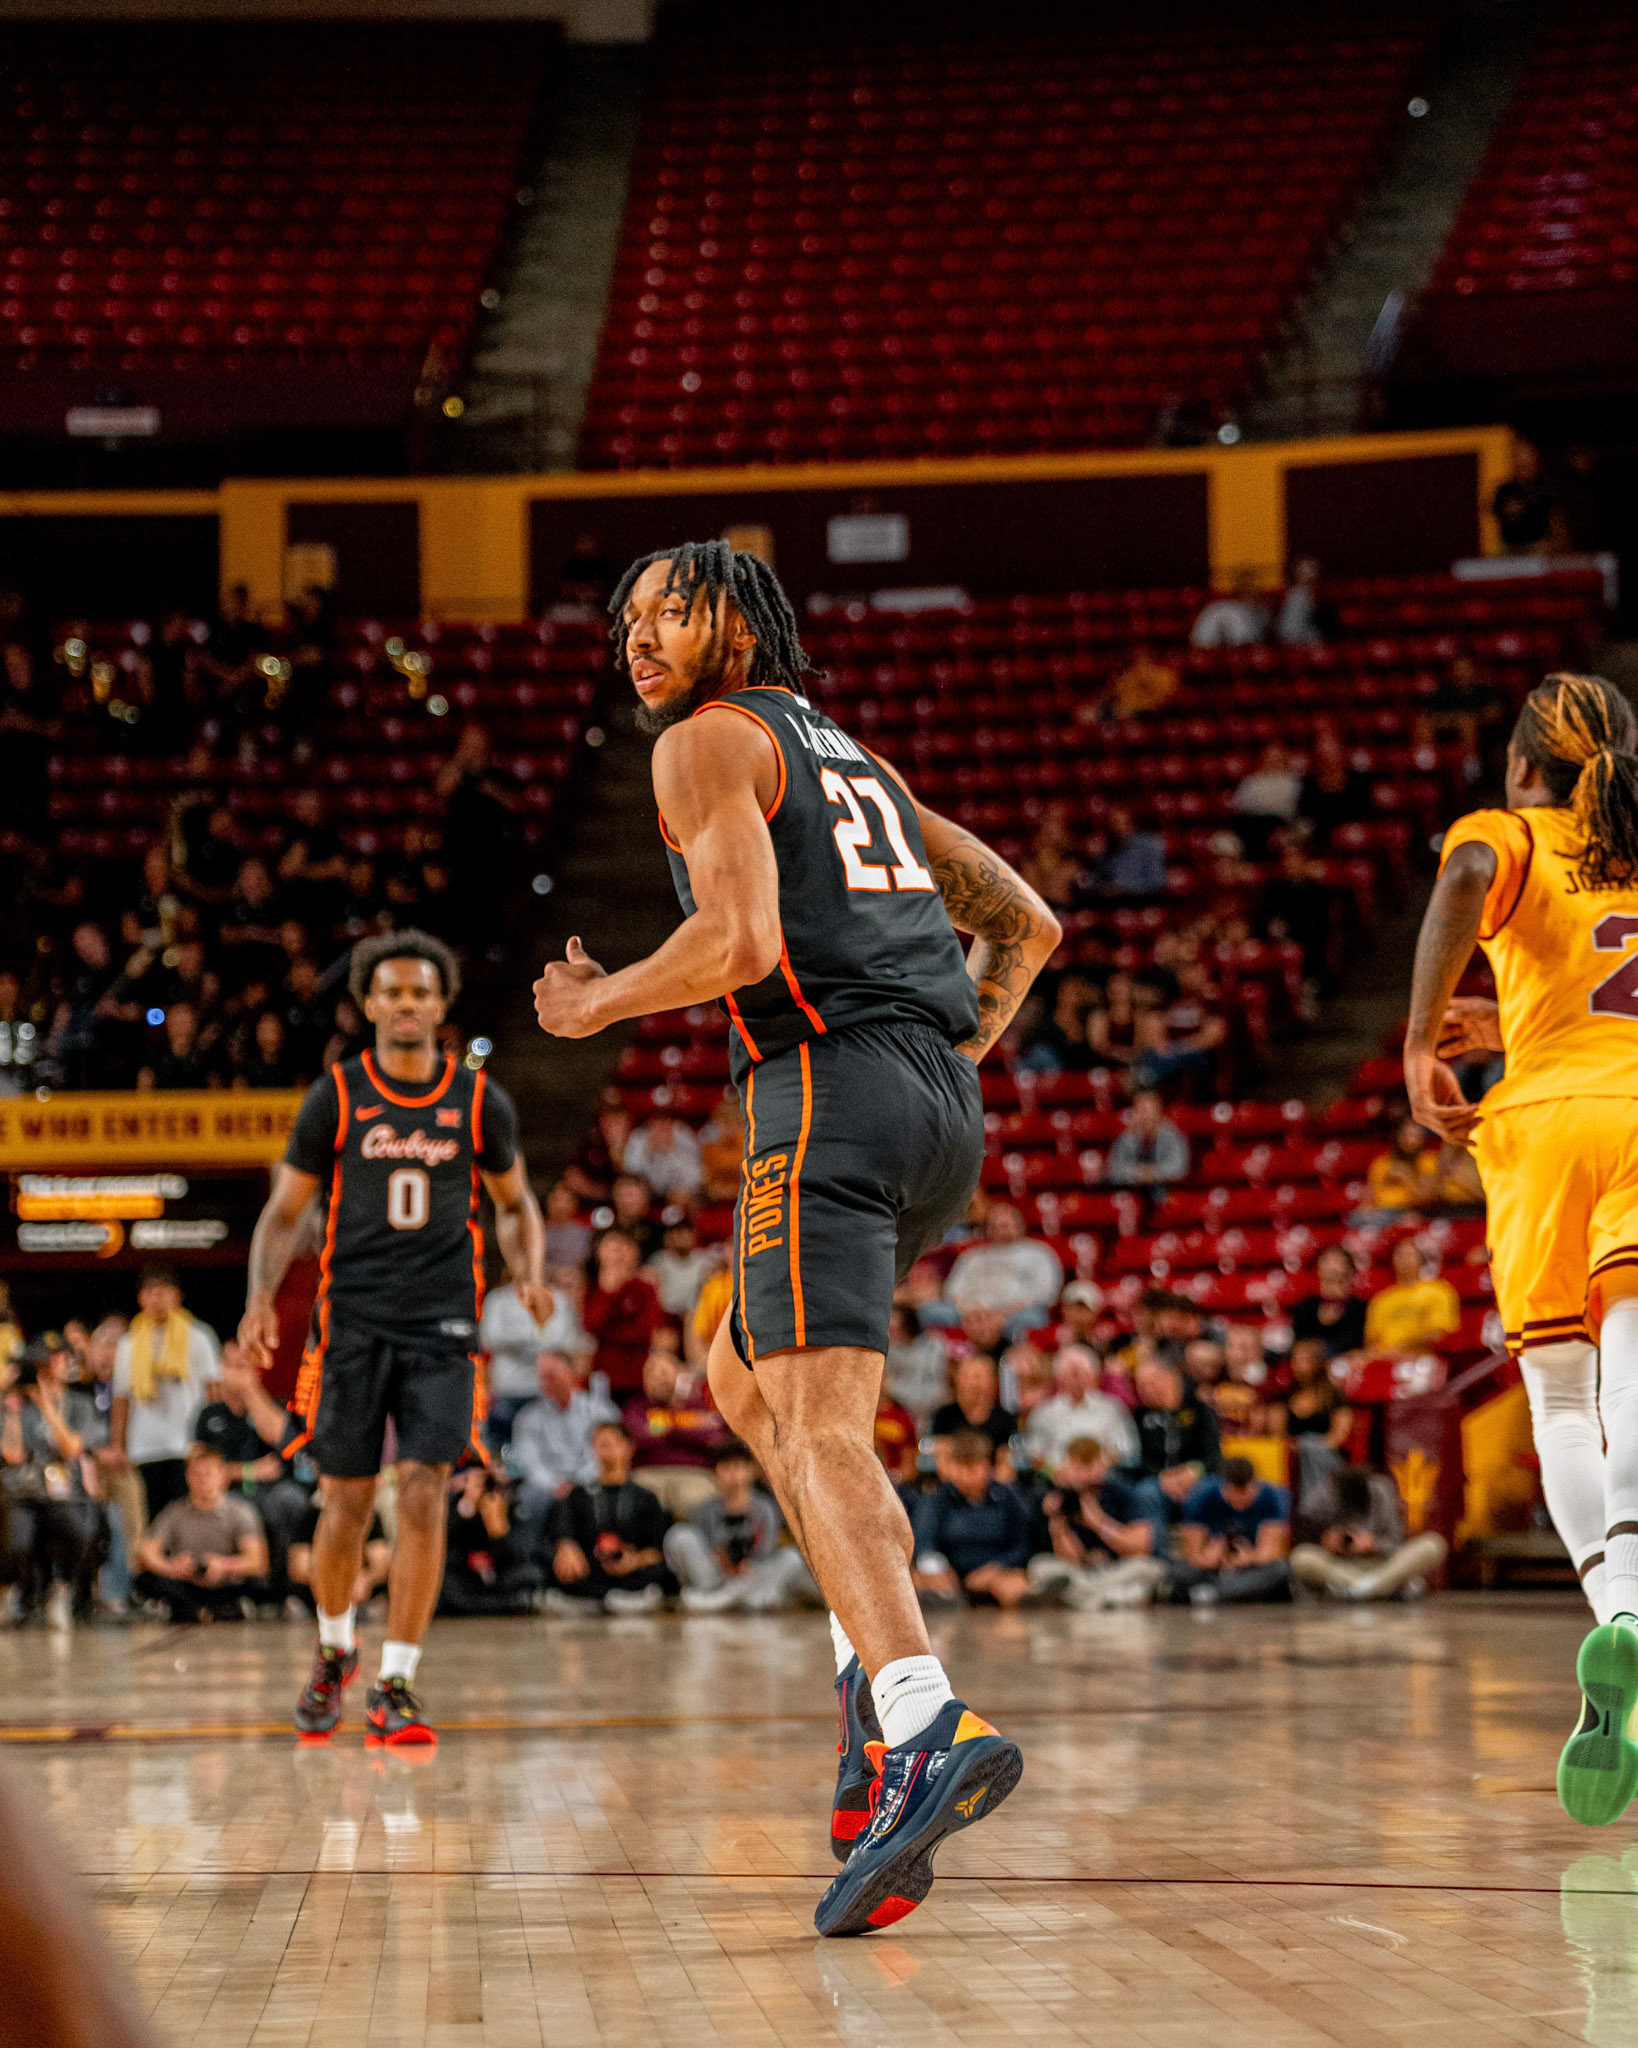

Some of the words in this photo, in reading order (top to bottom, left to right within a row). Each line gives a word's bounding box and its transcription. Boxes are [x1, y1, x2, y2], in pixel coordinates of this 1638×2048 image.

[802, 714, 869, 766] LEMAN
[820, 766, 936, 892] 21
[103, 1111, 200, 1139] ENTER
[361, 1123, 459, 1168] Cowboys
[387, 1168, 431, 1231] 0
[748, 1153, 788, 1257] POKES
